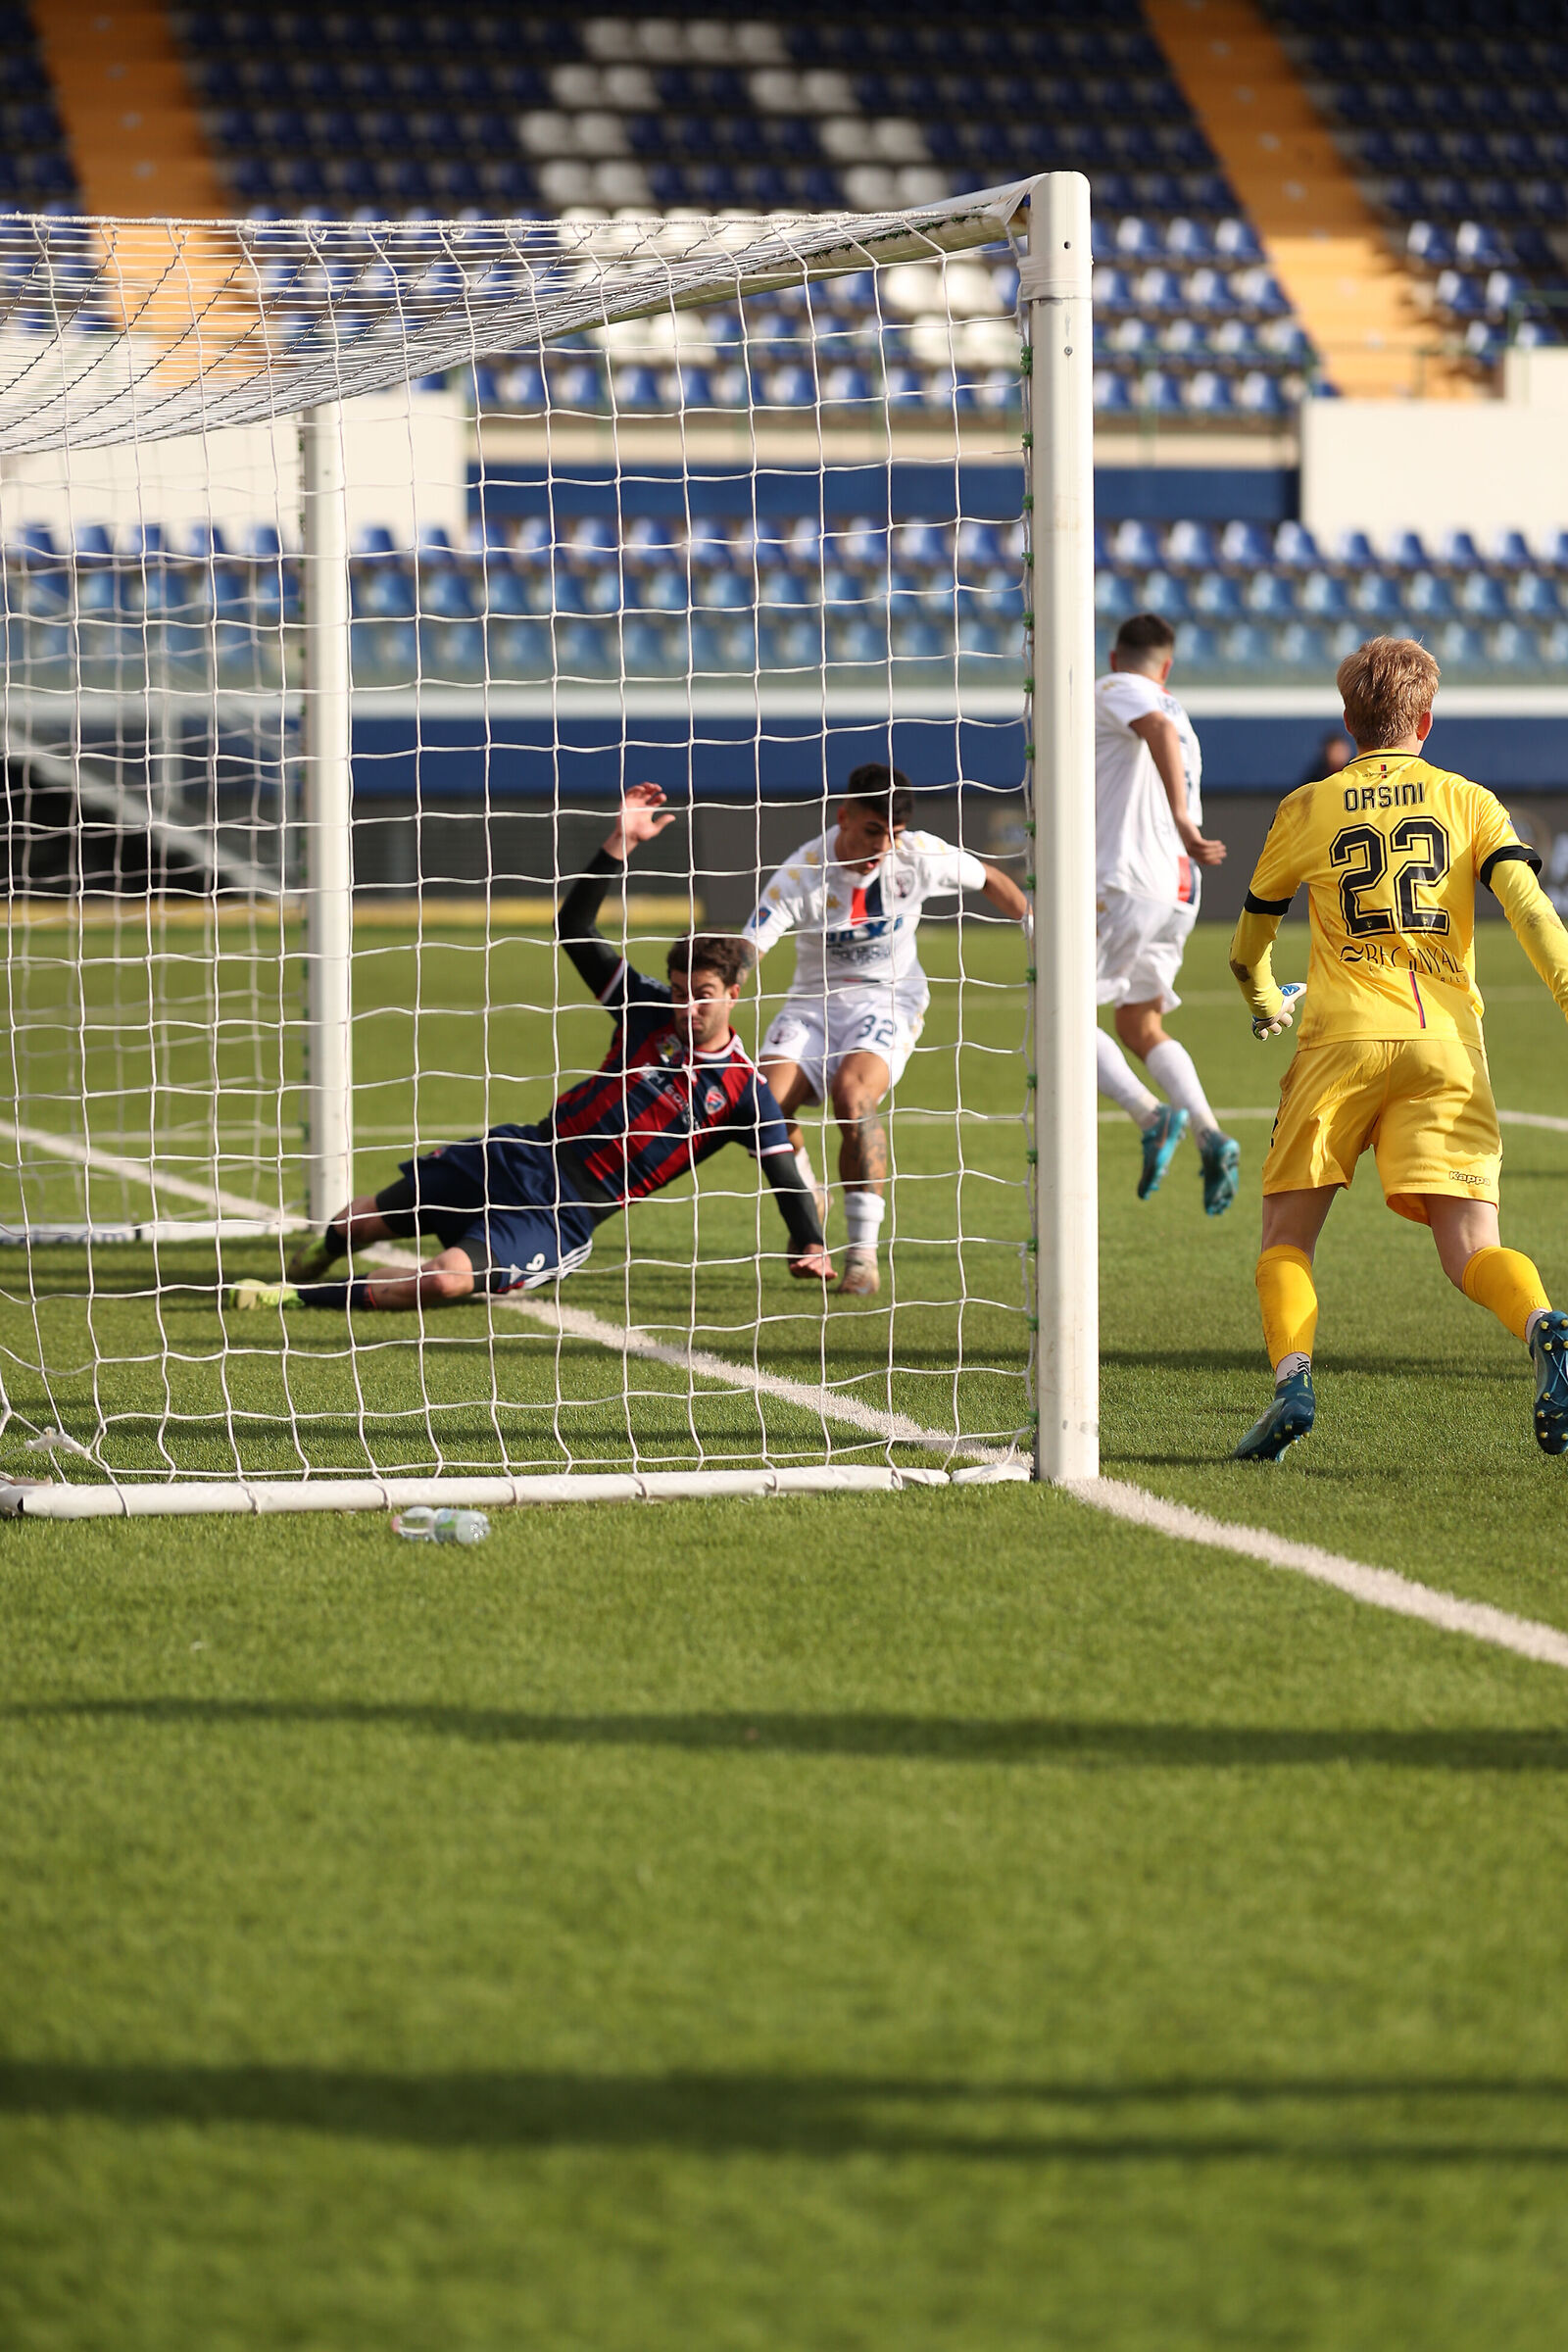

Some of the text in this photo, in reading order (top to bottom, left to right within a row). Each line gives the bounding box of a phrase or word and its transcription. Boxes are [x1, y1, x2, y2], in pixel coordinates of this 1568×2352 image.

[1344, 782, 1425, 812] ORSINI
[1329, 815, 1450, 939] 22
[857, 1014, 897, 1048] 32
[1449, 1170, 1490, 1186] Kappa
